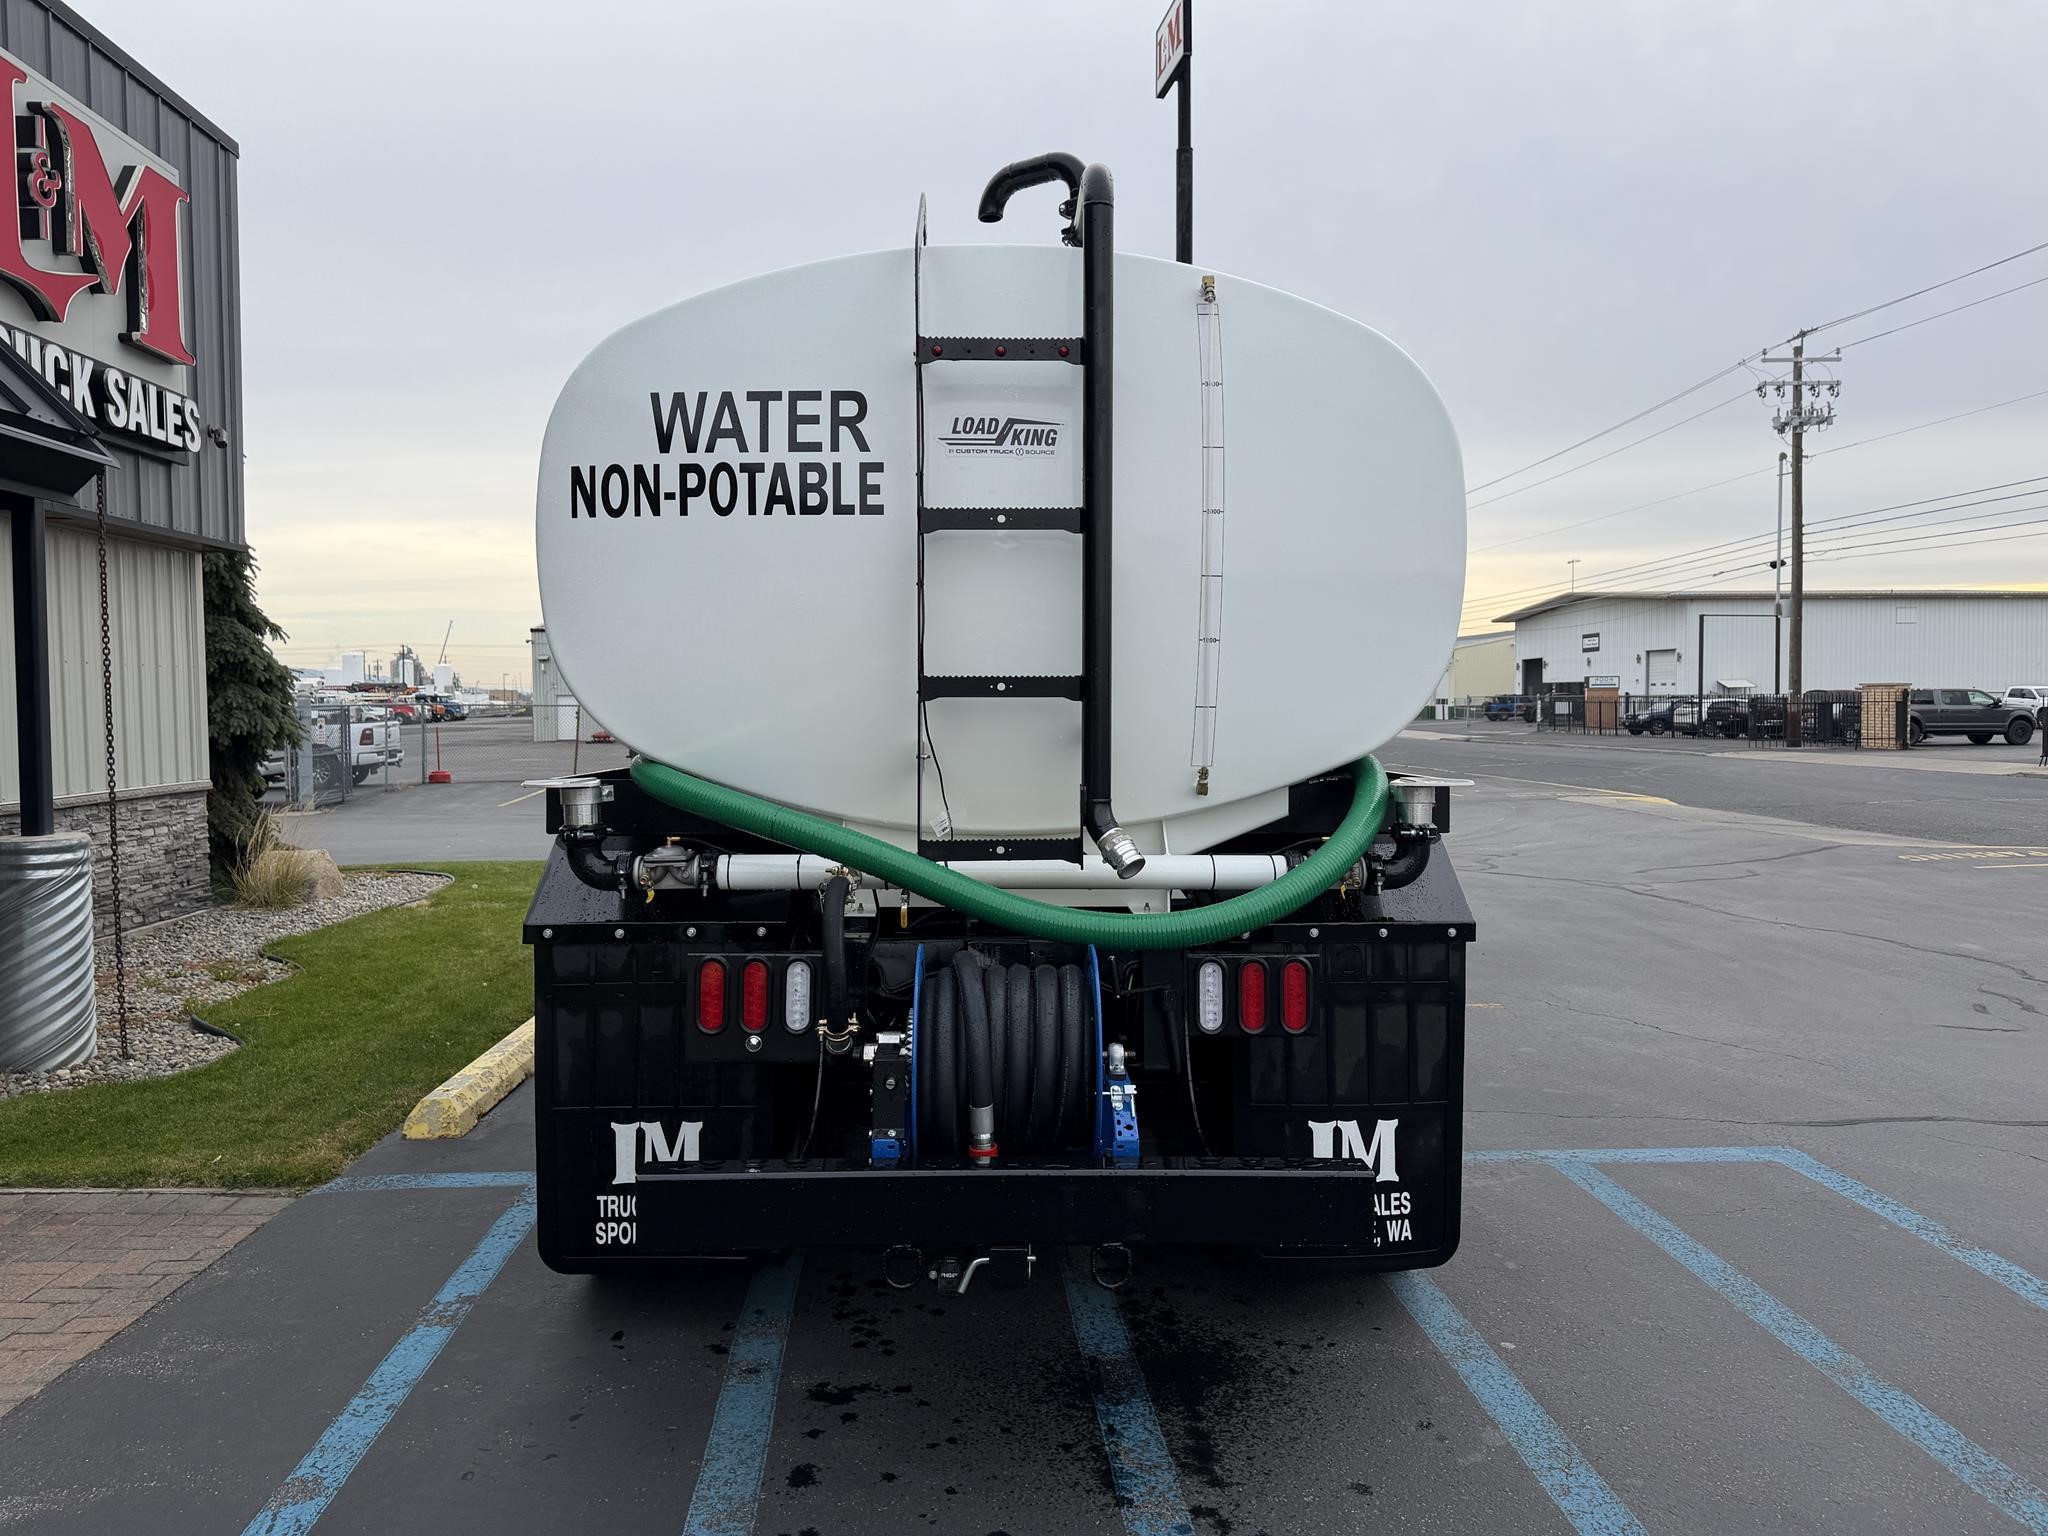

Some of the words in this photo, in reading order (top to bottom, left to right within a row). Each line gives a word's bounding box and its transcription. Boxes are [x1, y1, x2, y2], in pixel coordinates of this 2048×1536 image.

[104, 368, 201, 453] SALES
[650, 390, 871, 453] WATER
[952, 417, 999, 434] LOAD
[1010, 428, 1058, 446] KING
[571, 462, 884, 518] NON-POTABLE
[596, 1222, 636, 1244] SPO
[1386, 1219, 1412, 1242] WA
